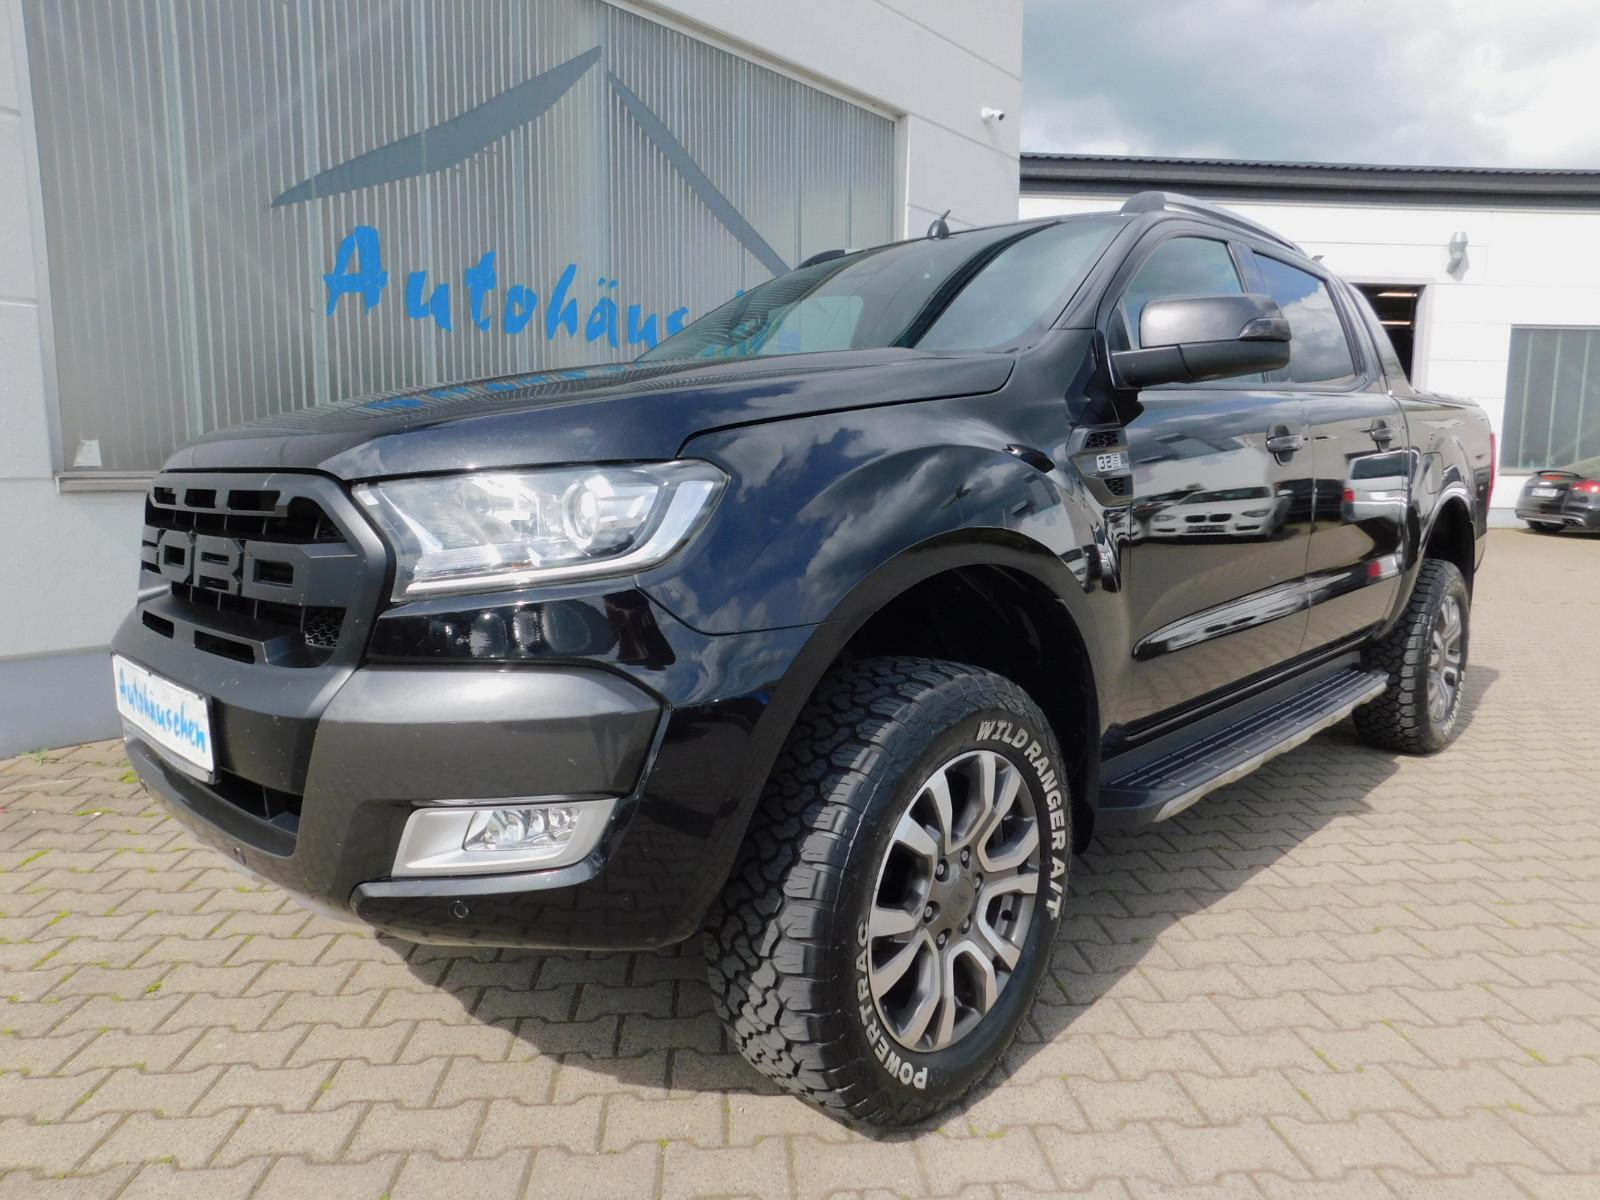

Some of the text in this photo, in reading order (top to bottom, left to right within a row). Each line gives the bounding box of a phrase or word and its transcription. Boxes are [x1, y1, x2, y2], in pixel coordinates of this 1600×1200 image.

[976, 720, 1026, 747] WILD
[1023, 740, 1066, 851] RANGER
[855, 920, 928, 1091] POWERTRAC
